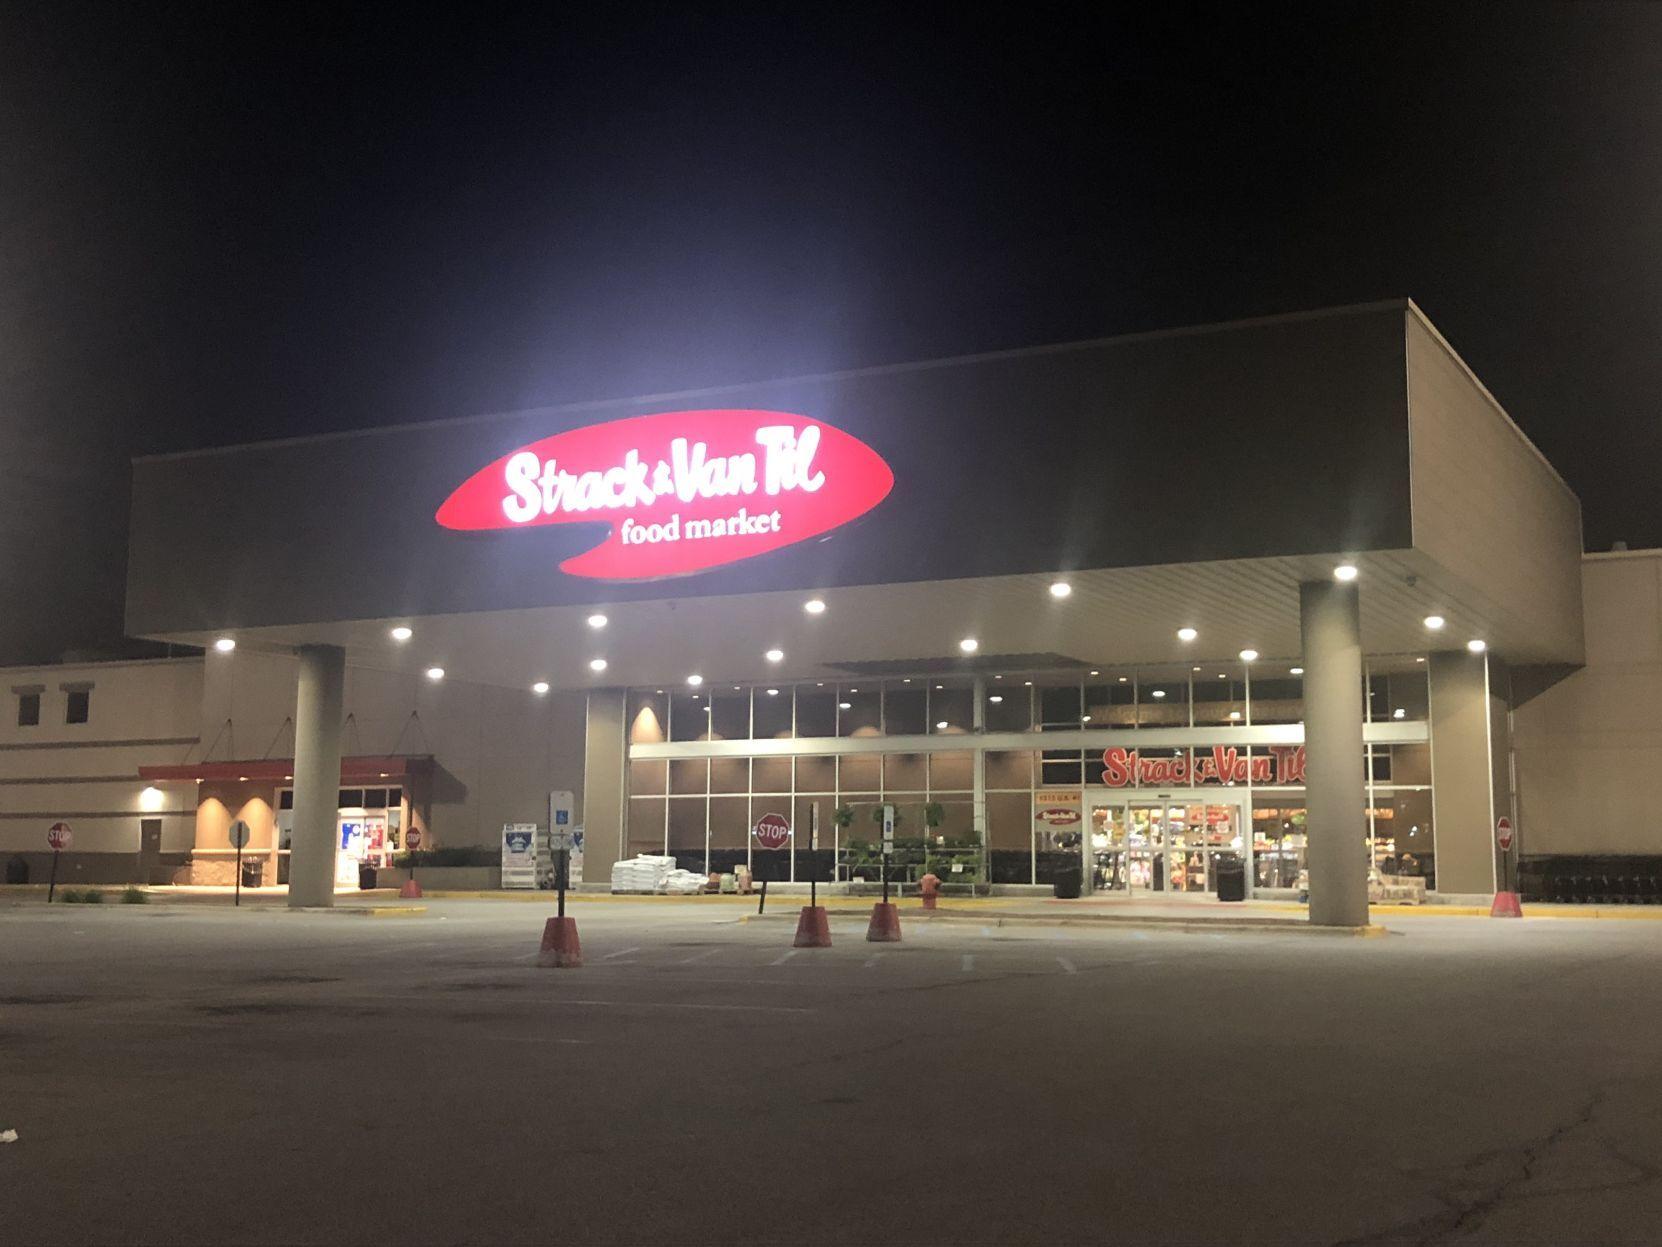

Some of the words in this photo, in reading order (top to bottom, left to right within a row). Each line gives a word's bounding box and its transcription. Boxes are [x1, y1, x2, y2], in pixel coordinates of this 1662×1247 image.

[503, 449, 656, 523] Strack
[671, 438, 758, 502] Van
[757, 425, 825, 496] Til
[621, 512, 680, 544] food
[685, 508, 781, 539] market
[1102, 747, 1205, 787] Strack
[1213, 745, 1272, 784] Van
[49, 830, 71, 842] STOP
[759, 823, 786, 839] STOP
